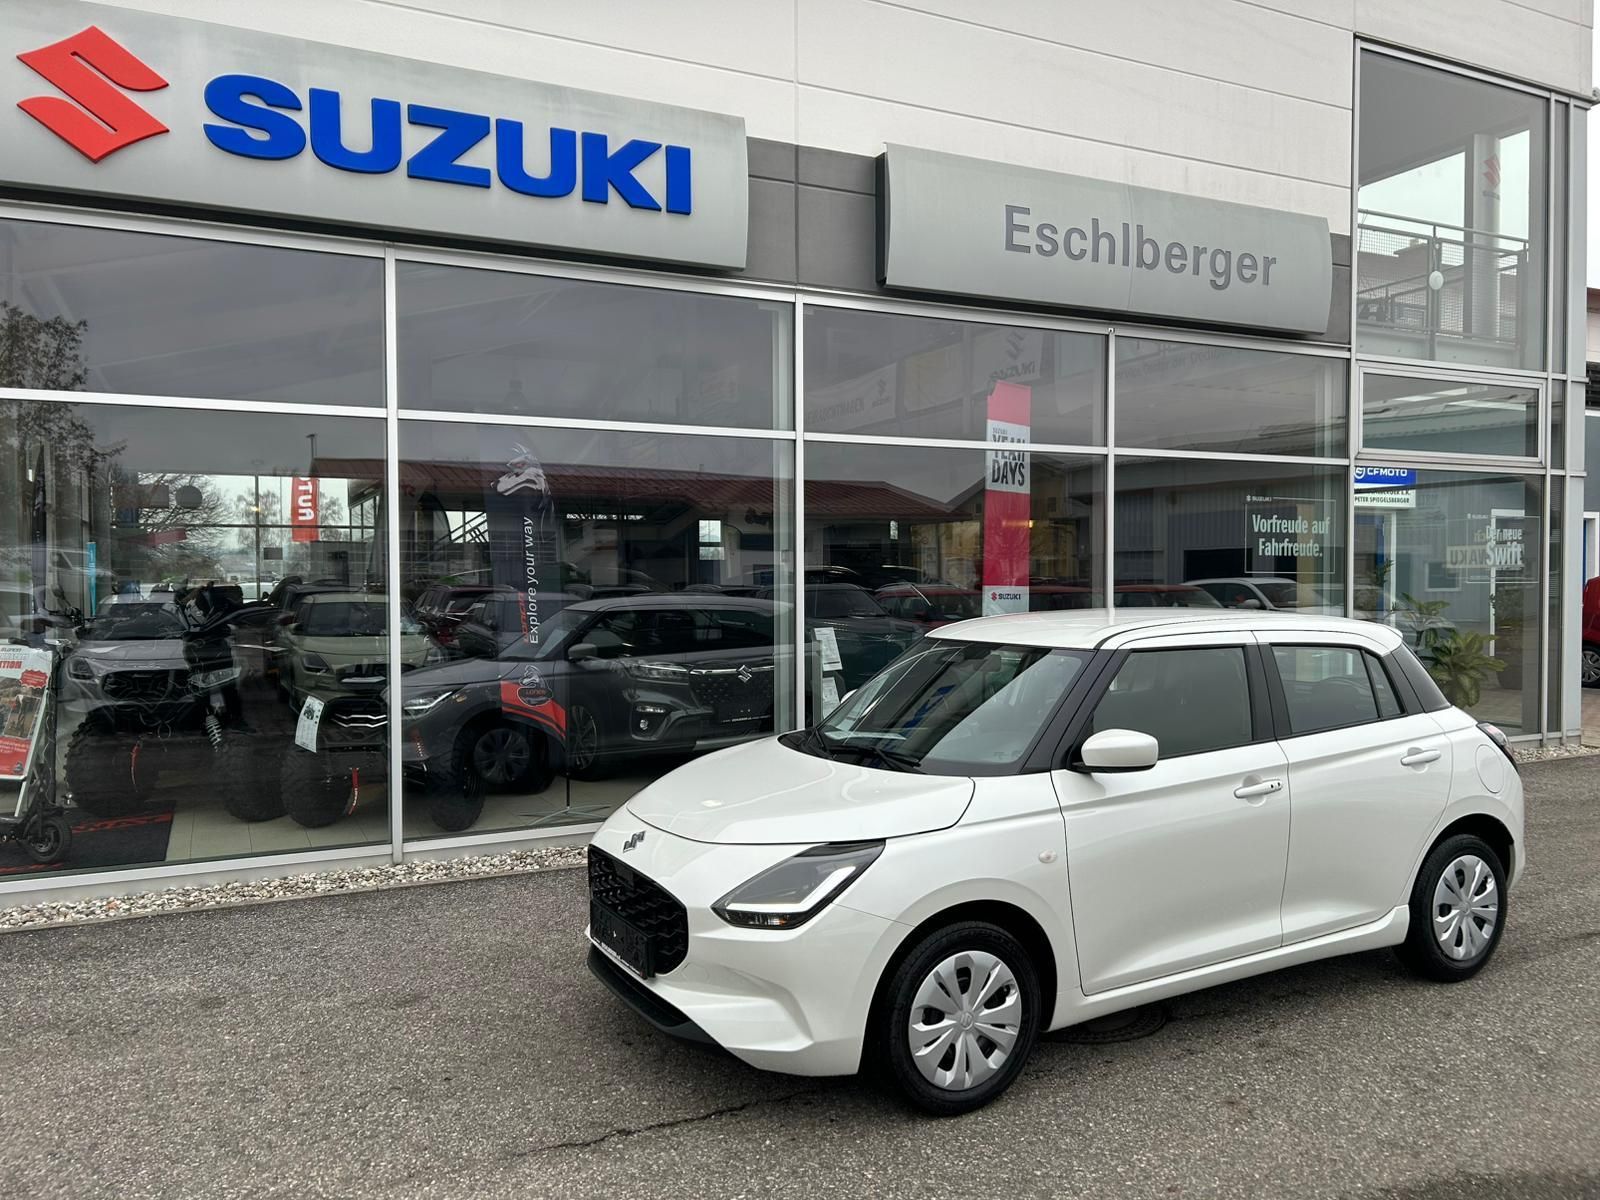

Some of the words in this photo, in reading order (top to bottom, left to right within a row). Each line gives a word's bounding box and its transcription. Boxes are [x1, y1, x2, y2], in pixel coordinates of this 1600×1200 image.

[203, 74, 691, 215] SUZUKI
[1004, 204, 1277, 291] Eschlberger
[991, 459, 1025, 487] DAYS
[1367, 468, 1408, 477] CFMOTO
[523, 516, 534, 549] way
[1252, 514, 1309, 533] Vorfreude
[1311, 517, 1331, 534] auf
[1486, 525, 1502, 540] Der
[1503, 527, 1522, 540] neue
[1258, 538, 1323, 557] Fahrfreude.
[1486, 541, 1523, 566] Swift
[525, 550, 539, 585] your
[526, 588, 540, 644] Explore
